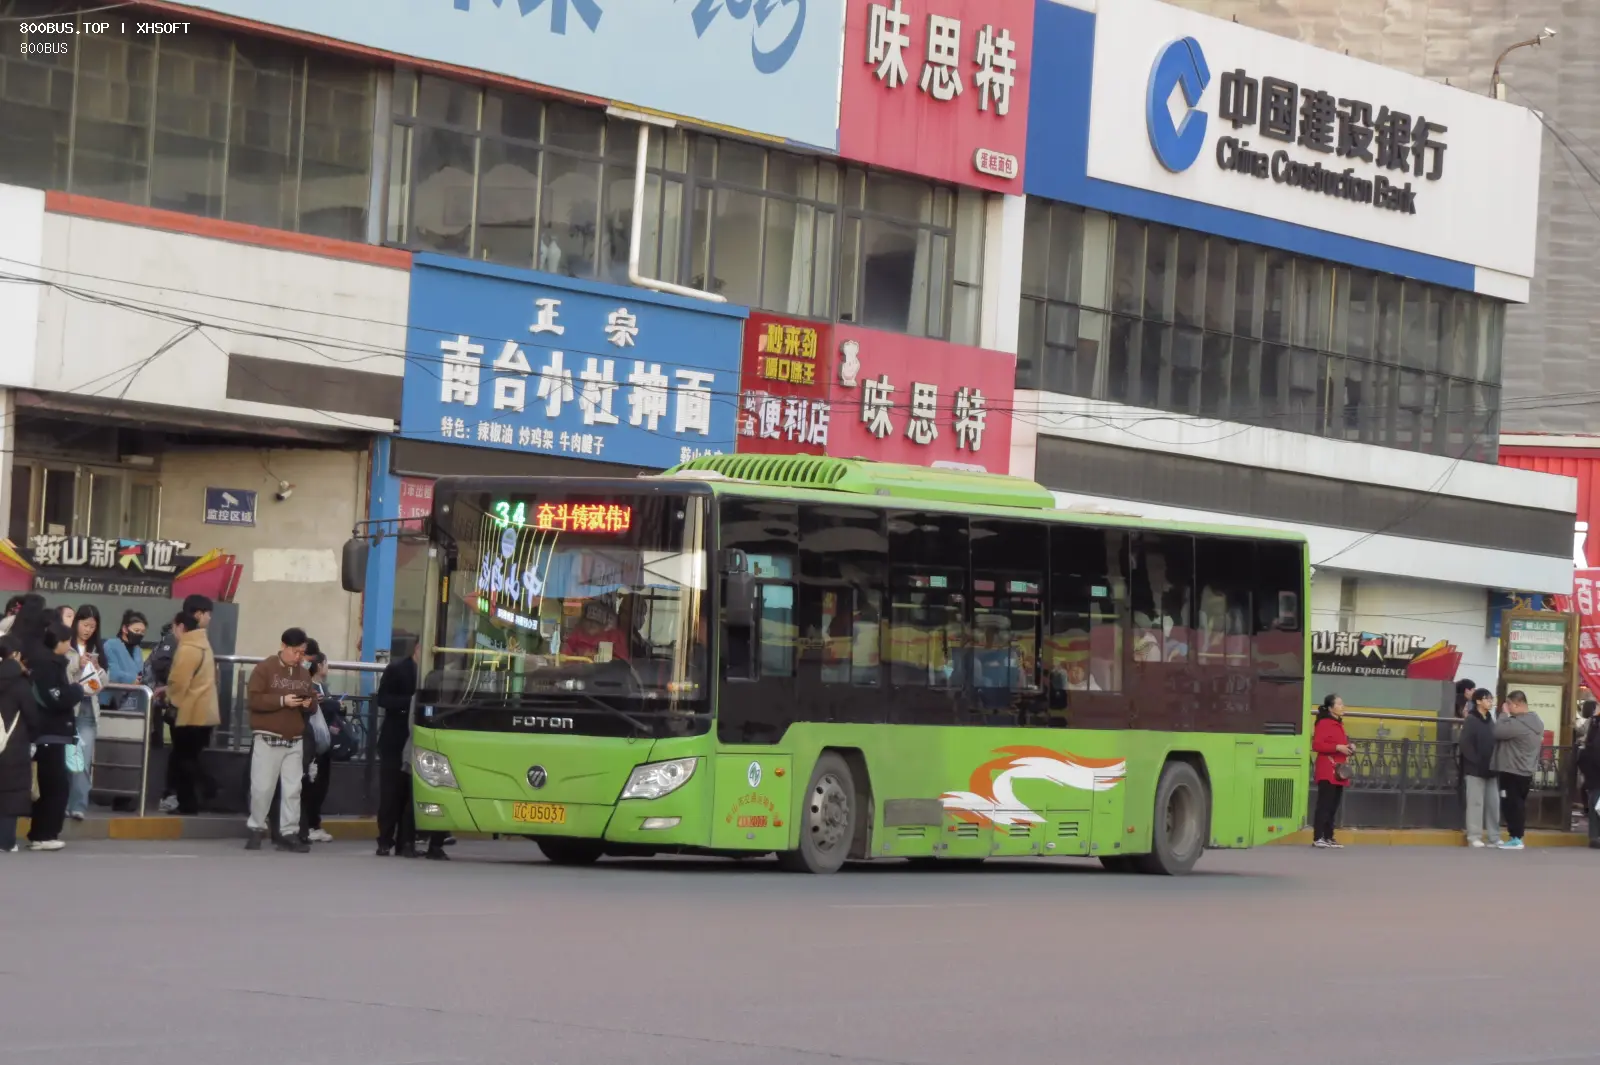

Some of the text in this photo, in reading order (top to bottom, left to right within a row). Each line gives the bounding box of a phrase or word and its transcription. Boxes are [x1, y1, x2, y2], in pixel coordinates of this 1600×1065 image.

[866, 0, 1016, 115] 味思特
[1218, 68, 1448, 181] 中国建设银行
[980, 152, 1013, 174] 蛋糕面包
[1216, 136, 1416, 215] China Construction Bank
[759, 393, 831, 446] 便利店
[861, 375, 987, 452] 味思特
[478, 420, 513, 445] 辣椒油
[519, 426, 554, 450] 炒鸡架
[207, 508, 253, 522] 监控区域
[496, 502, 526, 528] 34
[512, 715, 574, 729] FOTON
